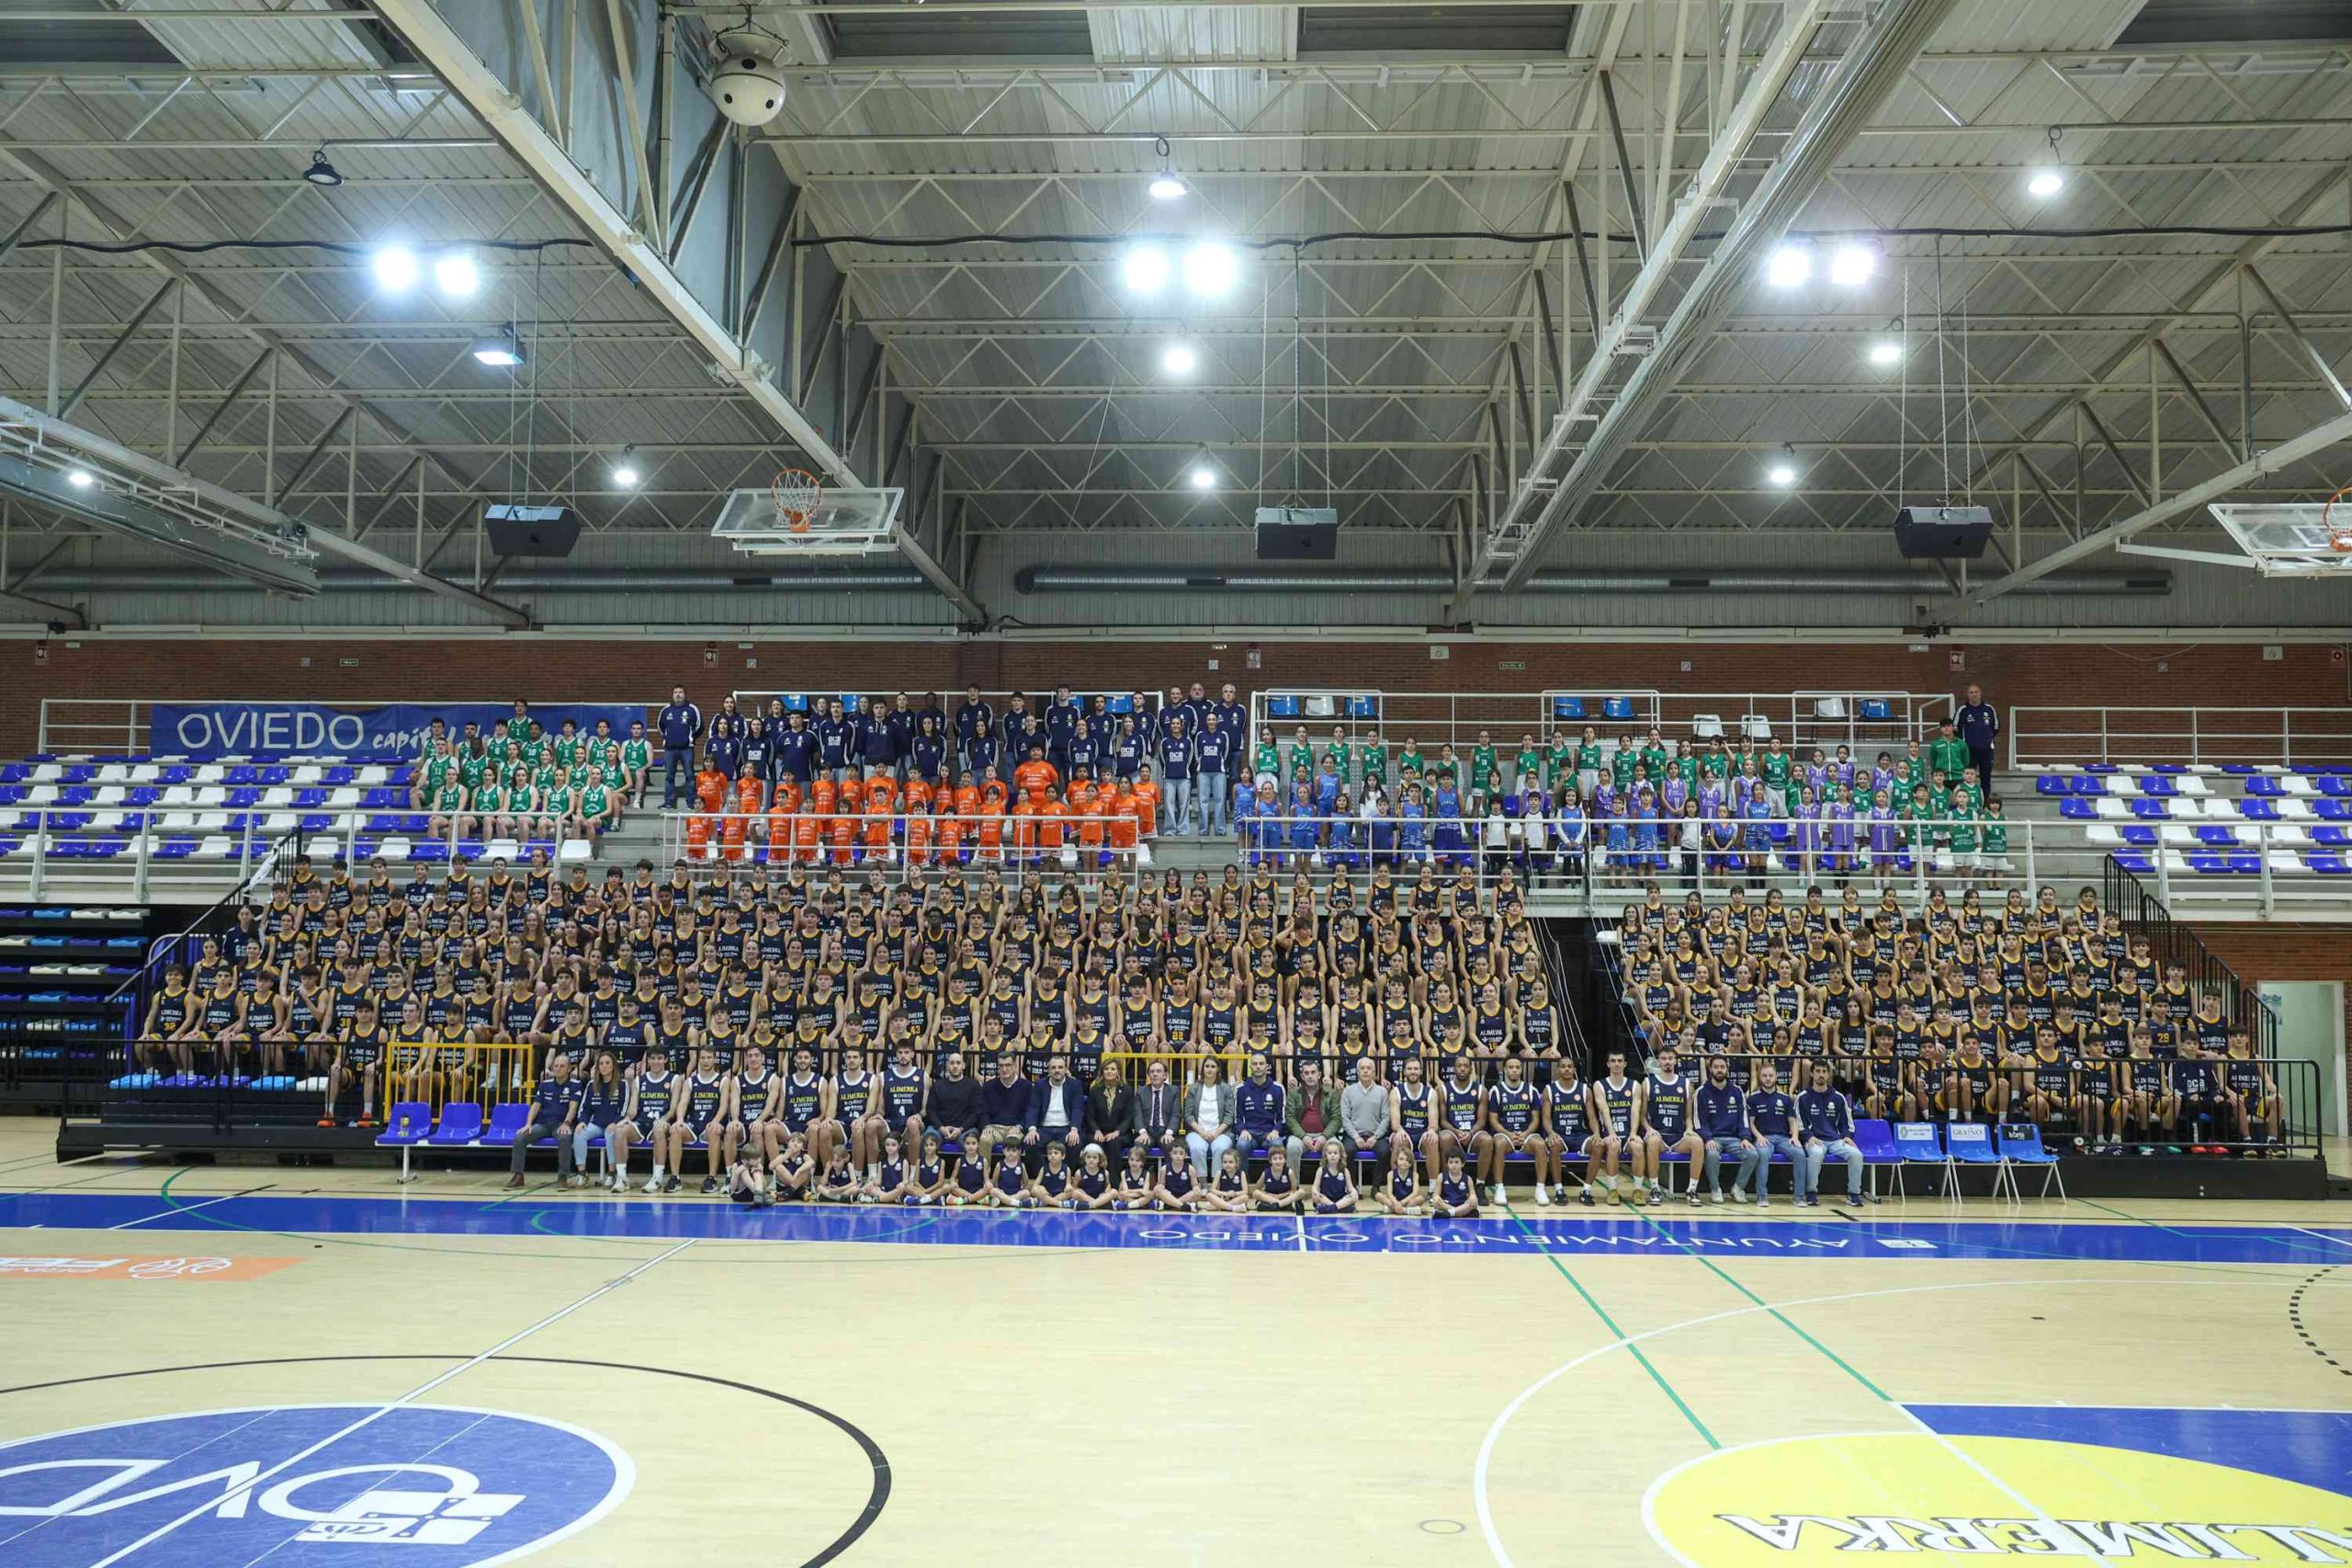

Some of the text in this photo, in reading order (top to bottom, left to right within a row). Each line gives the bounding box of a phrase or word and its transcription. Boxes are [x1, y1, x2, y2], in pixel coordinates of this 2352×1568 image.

[177, 711, 365, 750] OVIEDO
[372, 723, 457, 755] capitl
[1121, 747, 1135, 755] OCB
[841, 1092, 867, 1100] ALIMERKA
[899, 1106, 905, 1116] 4
[699, 1112, 707, 1121] 7
[1138, 1229, 1849, 1248] AYUNTAMIENTO OVIEDO
